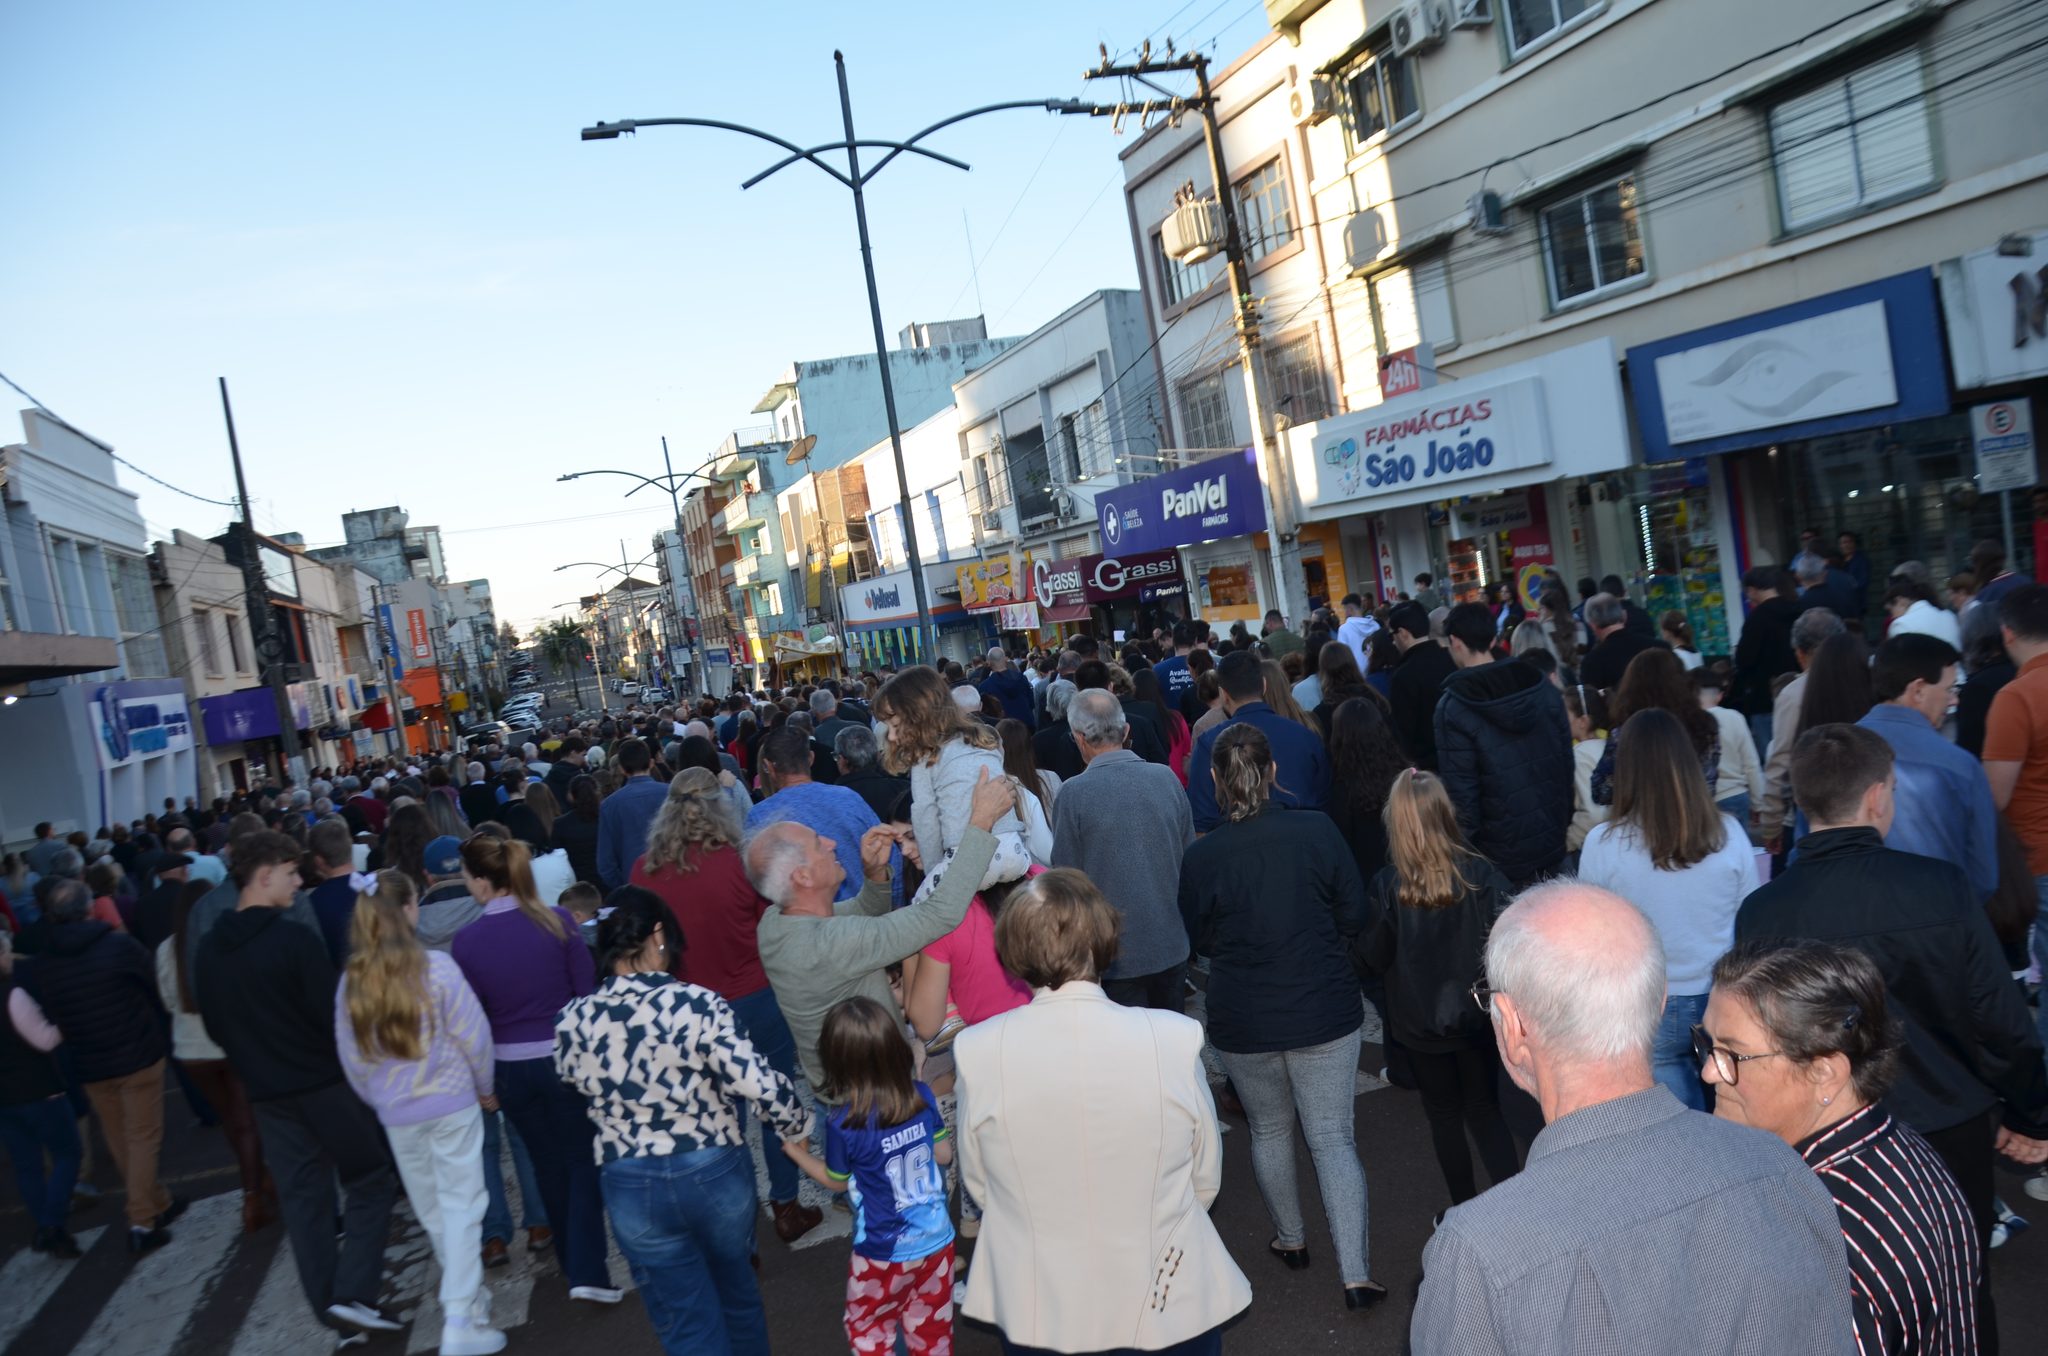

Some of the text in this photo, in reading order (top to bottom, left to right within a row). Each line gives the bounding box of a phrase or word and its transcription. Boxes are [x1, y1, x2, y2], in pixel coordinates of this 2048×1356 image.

[1365, 399, 1492, 447] FARMÁCIAS
[1366, 426, 1494, 488] São João
[1162, 474, 1227, 521] PanVel
[1202, 512, 1228, 528] FARMÁCIAS
[1034, 559, 1082, 608] Grassi
[1089, 555, 1176, 592] Grassi
[881, 1122, 926, 1154] SAMIRA
[885, 1143, 931, 1213] 16
